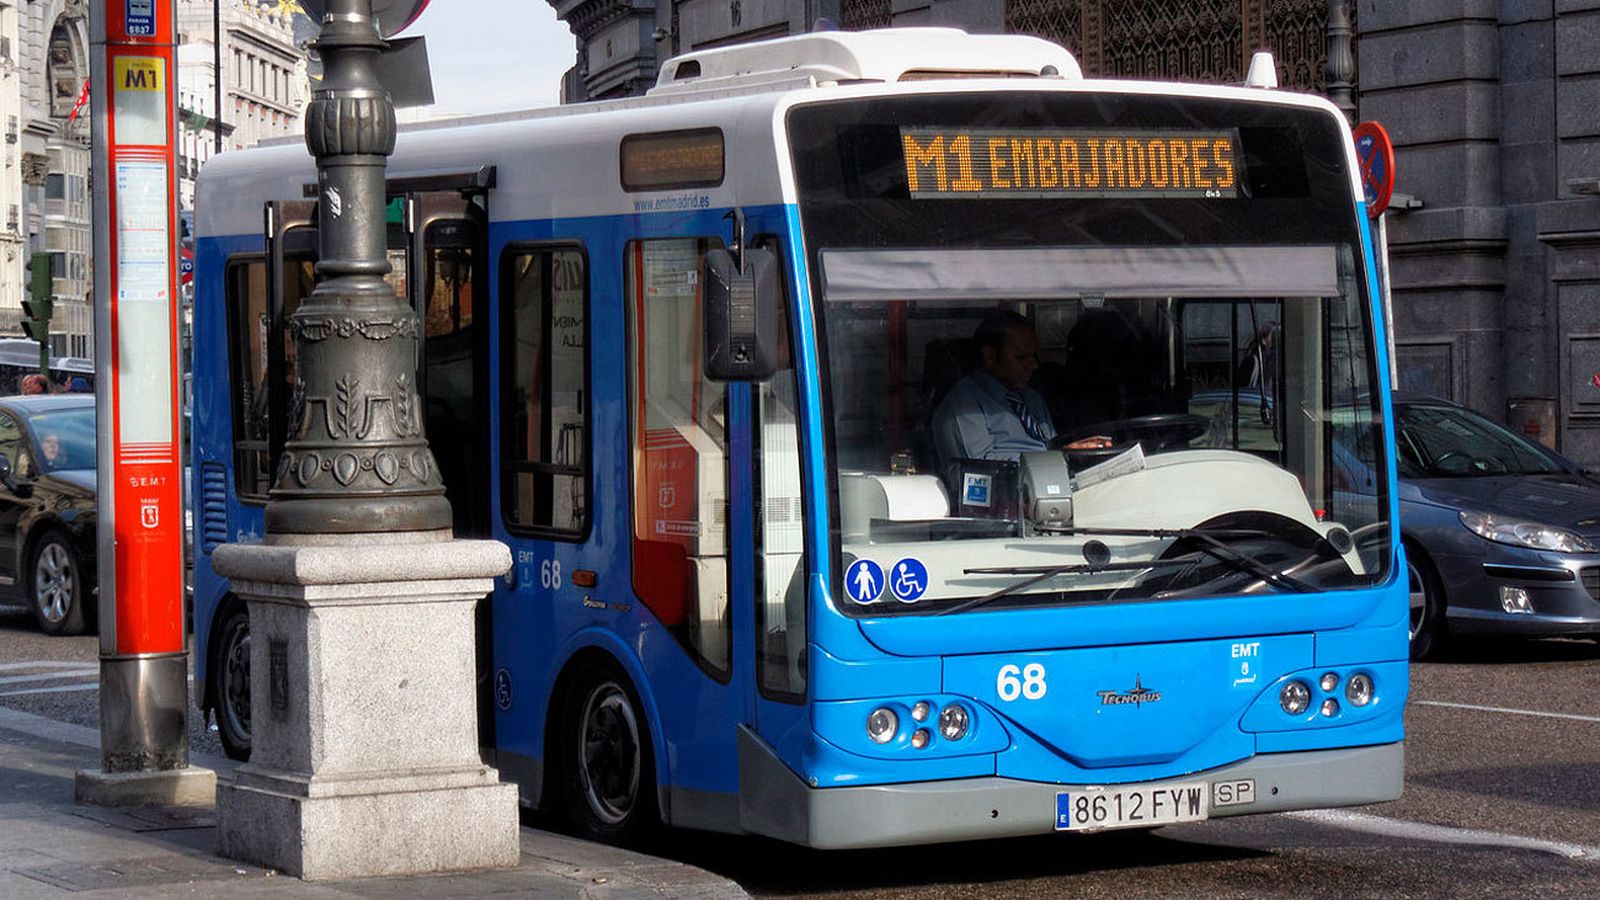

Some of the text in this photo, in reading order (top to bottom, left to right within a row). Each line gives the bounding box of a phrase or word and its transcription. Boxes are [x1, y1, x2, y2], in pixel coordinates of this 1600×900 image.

[125, 69, 157, 88] M1
[903, 135, 1234, 192] M1 EMBAJADORES
[519, 551, 534, 564] EMT
[541, 559, 562, 590] 68
[1231, 643, 1260, 659] EMT
[996, 663, 1048, 702] 68
[1218, 783, 1251, 803] SP
[1075, 787, 1202, 824] 8612 FYW
[1060, 814, 1067, 823] E
